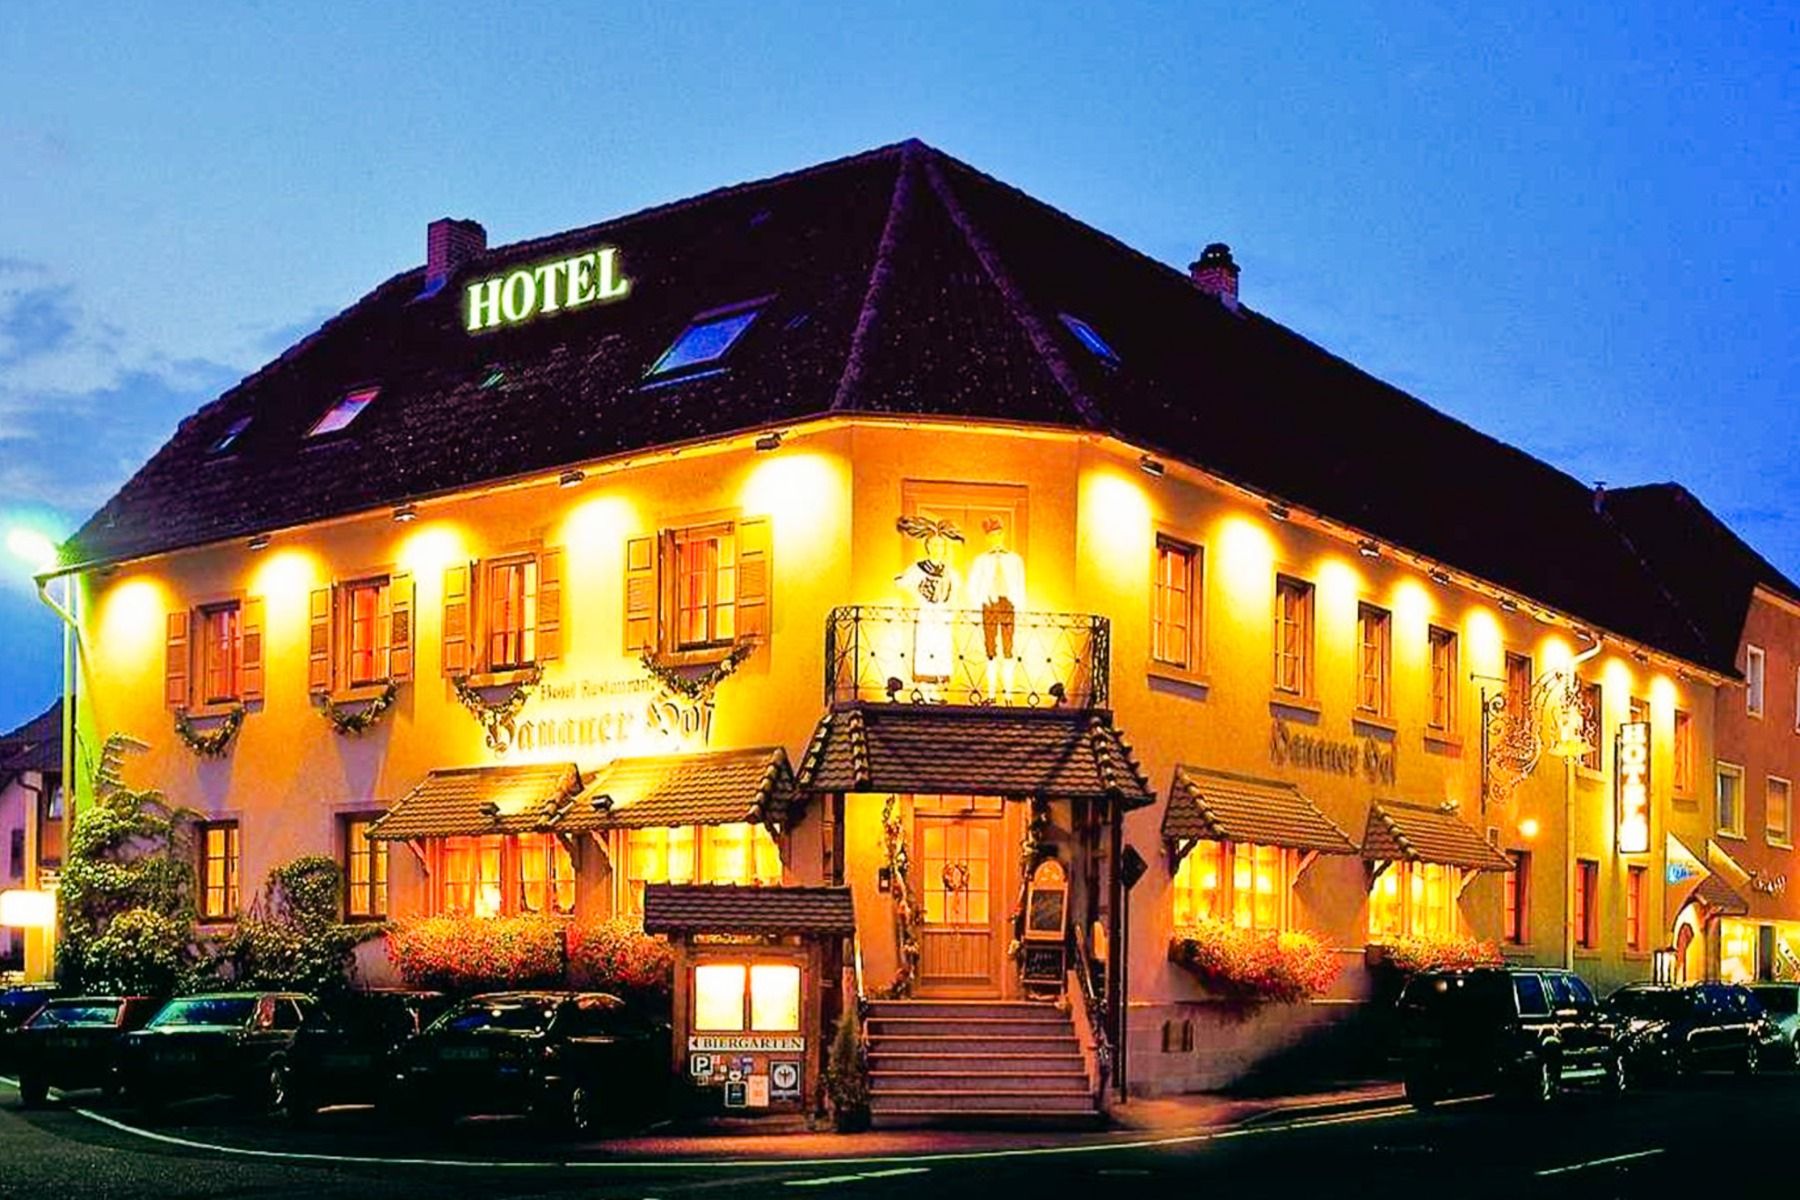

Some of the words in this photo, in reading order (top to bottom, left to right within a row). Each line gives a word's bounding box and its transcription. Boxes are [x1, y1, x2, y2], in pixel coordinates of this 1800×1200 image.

[467, 248, 629, 331] HOTEL
[703, 1037, 802, 1049] BIERGARTEN
[696, 1057, 709, 1072] P
